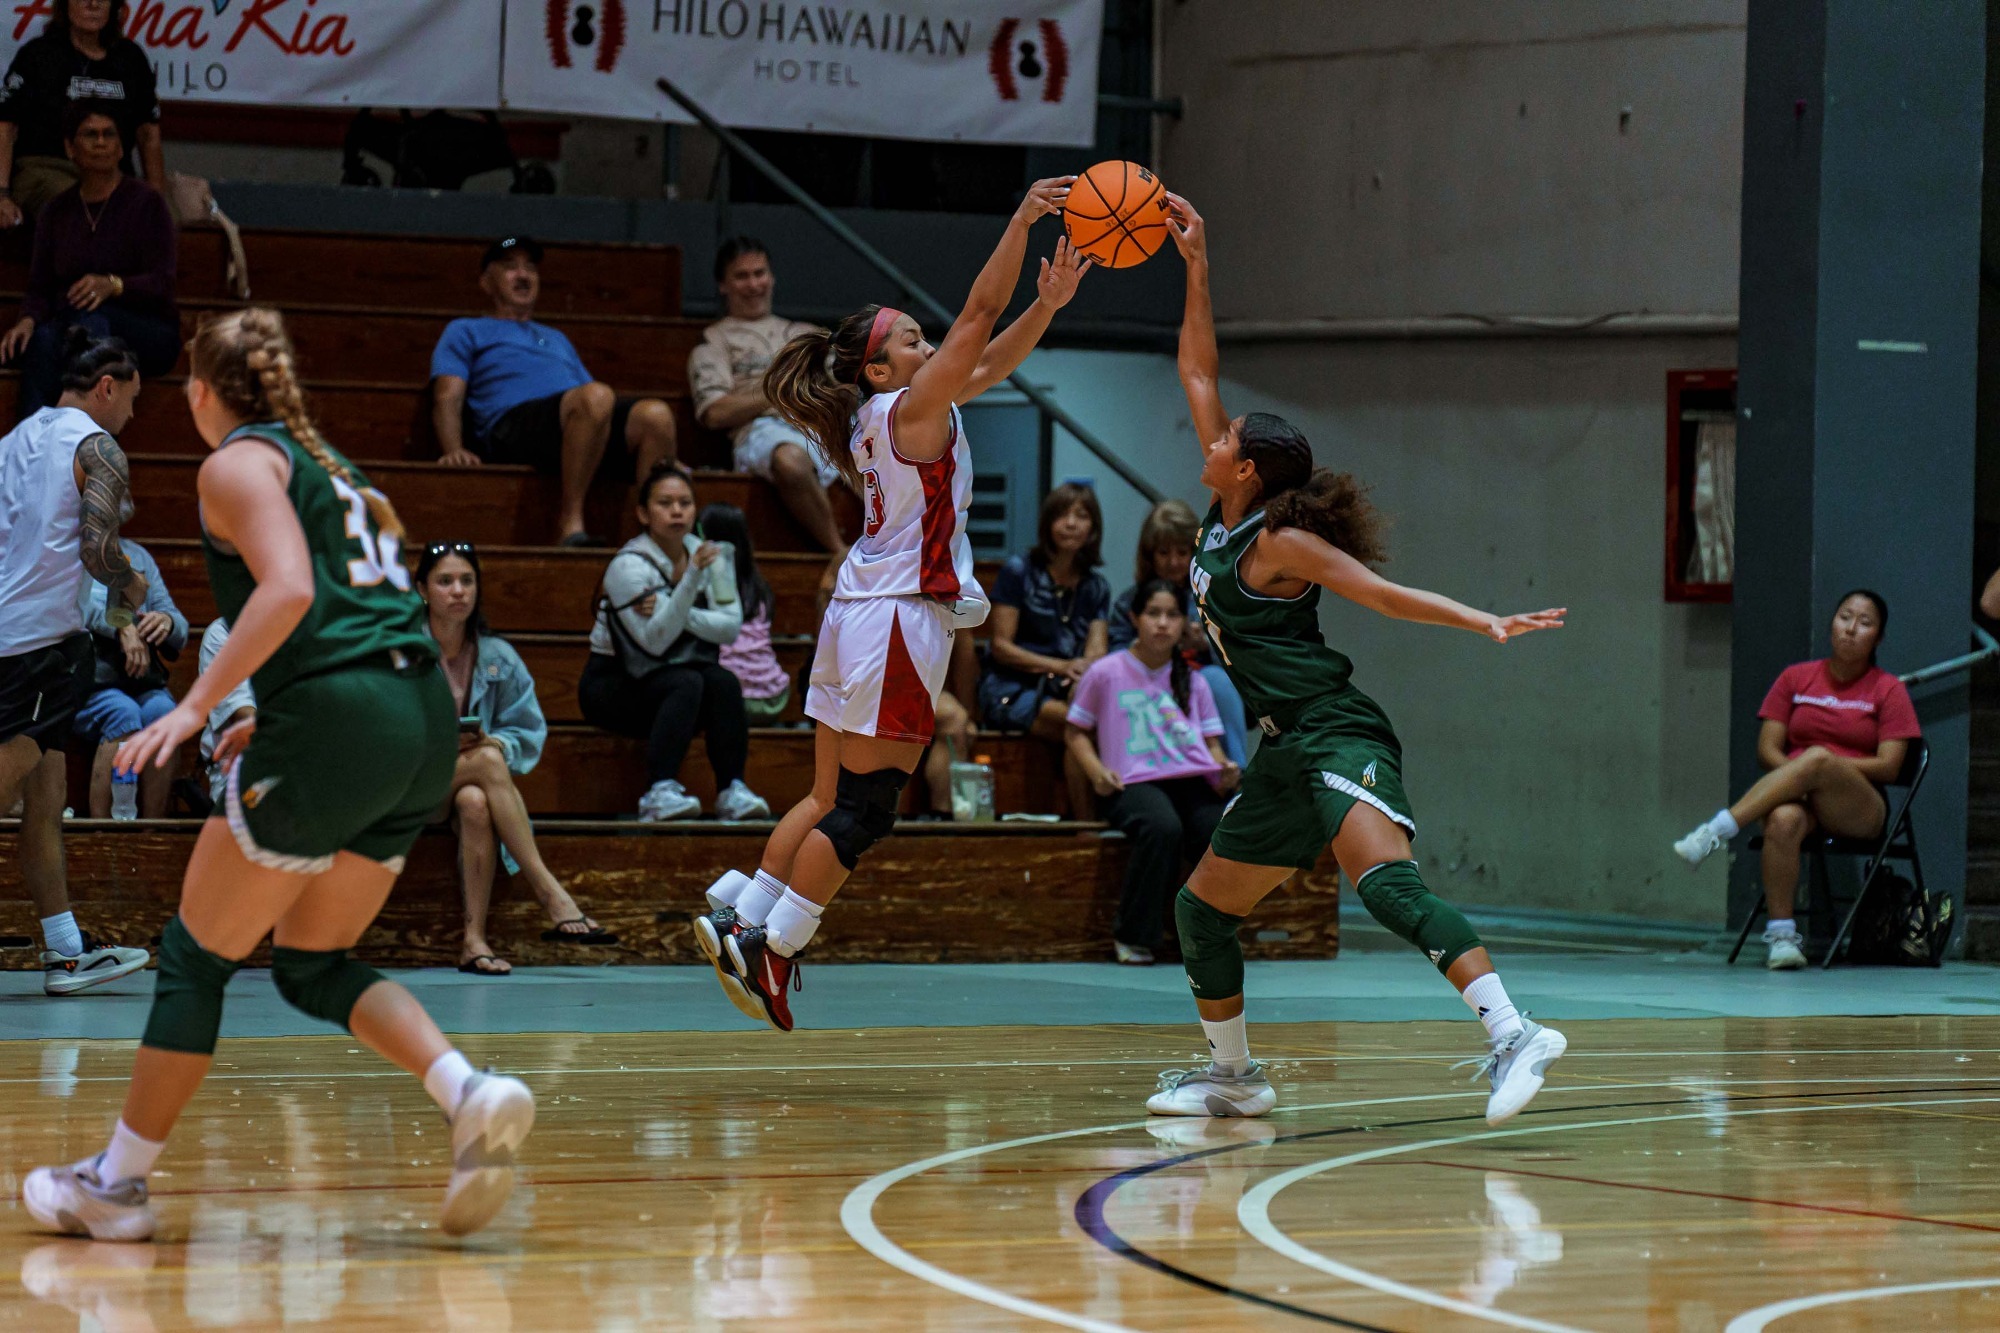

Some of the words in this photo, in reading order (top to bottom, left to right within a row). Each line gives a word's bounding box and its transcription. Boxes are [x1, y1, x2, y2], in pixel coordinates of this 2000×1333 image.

[225, 0, 355, 56] Kia
[652, 0, 749, 40] HILO
[757, 2, 971, 56] HAWAIIAN
[754, 58, 860, 88] HOTEL
